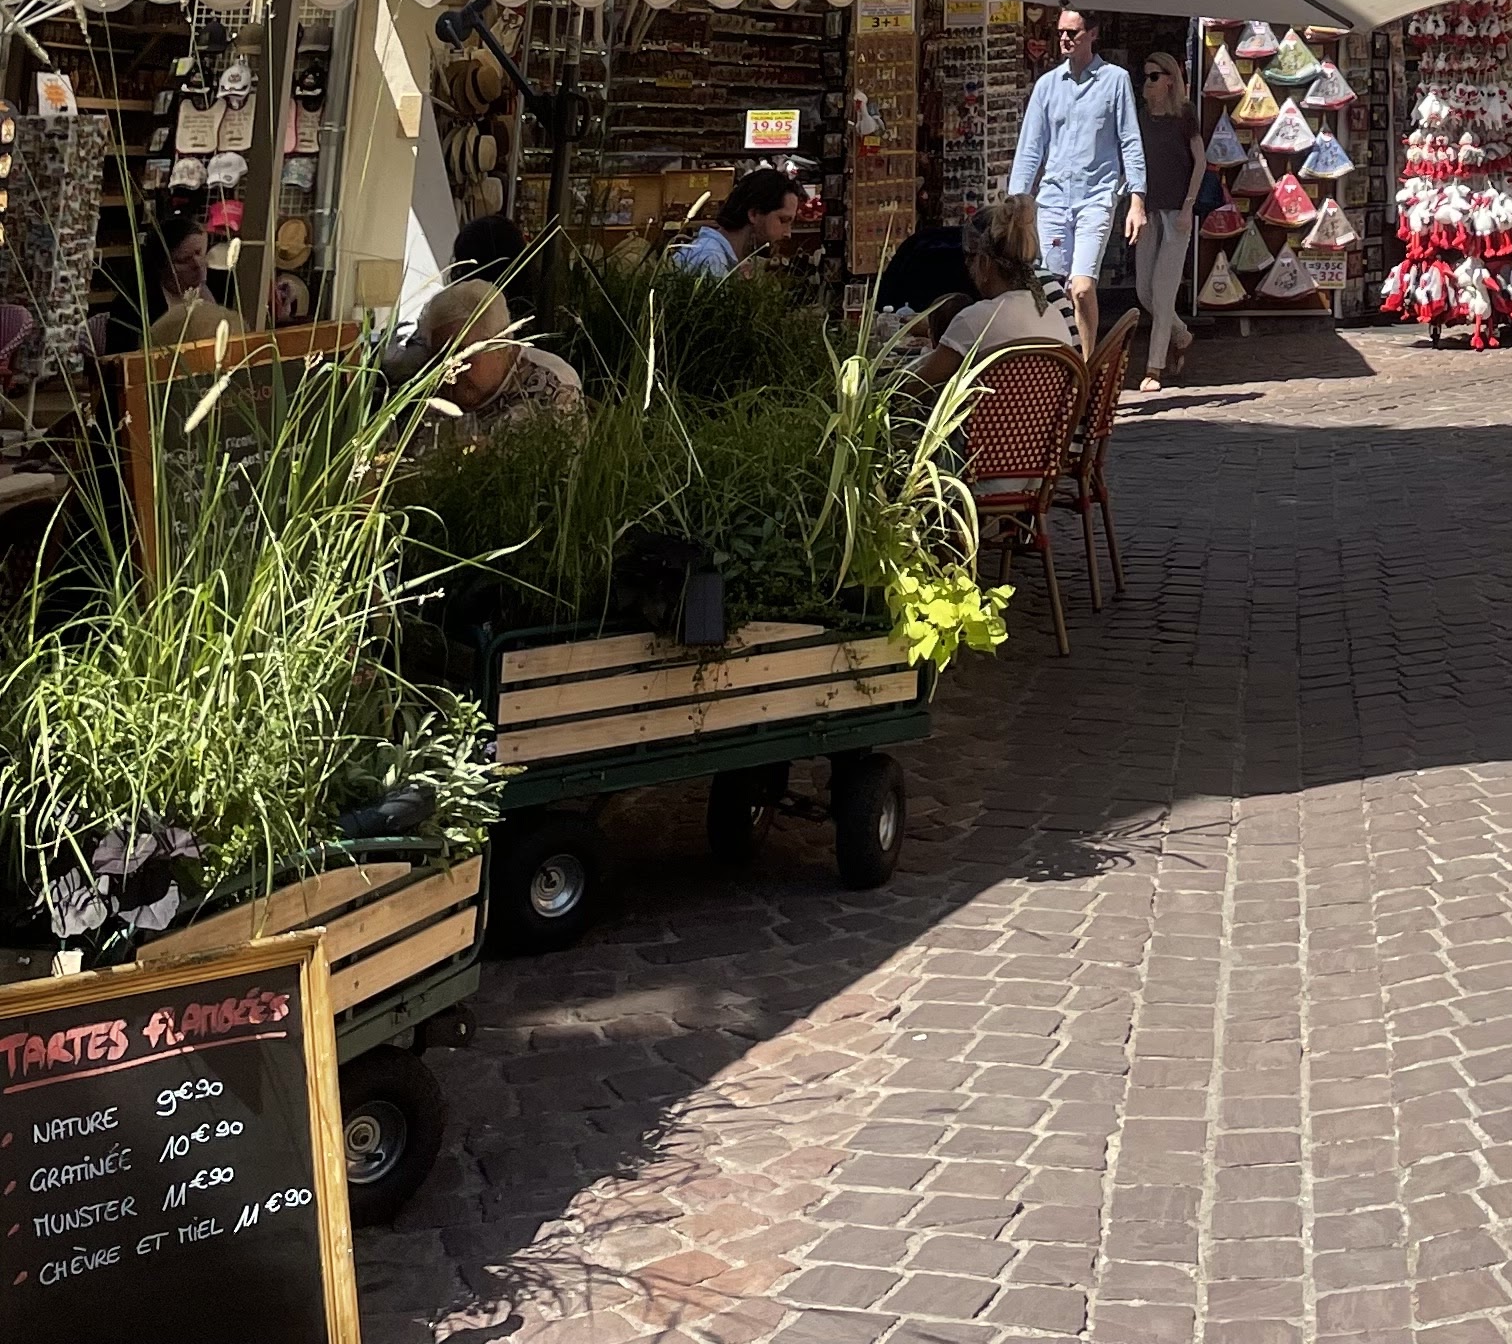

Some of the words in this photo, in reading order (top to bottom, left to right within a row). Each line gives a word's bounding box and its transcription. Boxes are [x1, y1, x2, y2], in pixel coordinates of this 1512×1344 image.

[872, 15, 901, 28] 3+1
[752, 120, 793, 132] 19.95
[0, 1019, 130, 1078] TARTES
[33, 1107, 120, 1144] NATURE
[33, 1196, 137, 1238] MUNSTER
[39, 1245, 121, 1286] CHÈVRE
[136, 1231, 169, 1255] ET
